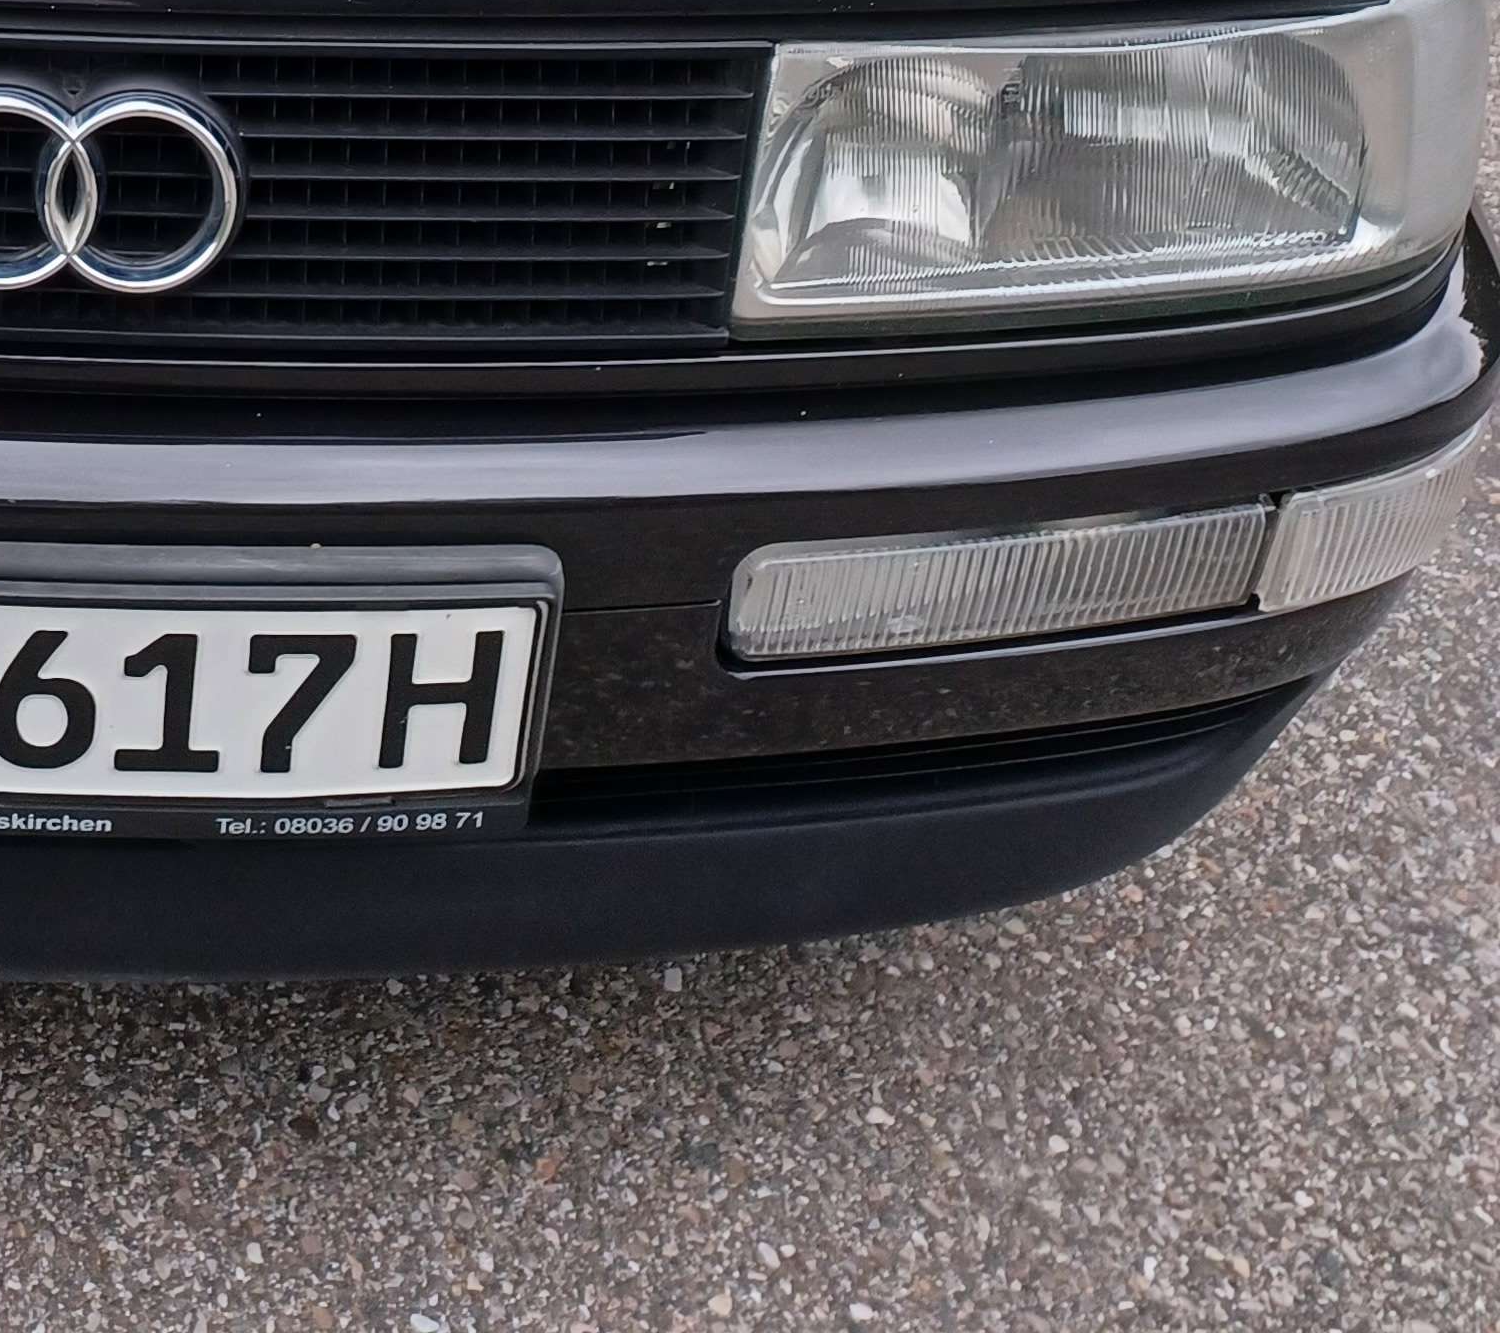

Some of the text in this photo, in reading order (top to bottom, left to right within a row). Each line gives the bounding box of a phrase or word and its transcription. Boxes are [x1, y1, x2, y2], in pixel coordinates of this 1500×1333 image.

[216, 811, 484, 835] Tel.: 08036 / 90 98 71
